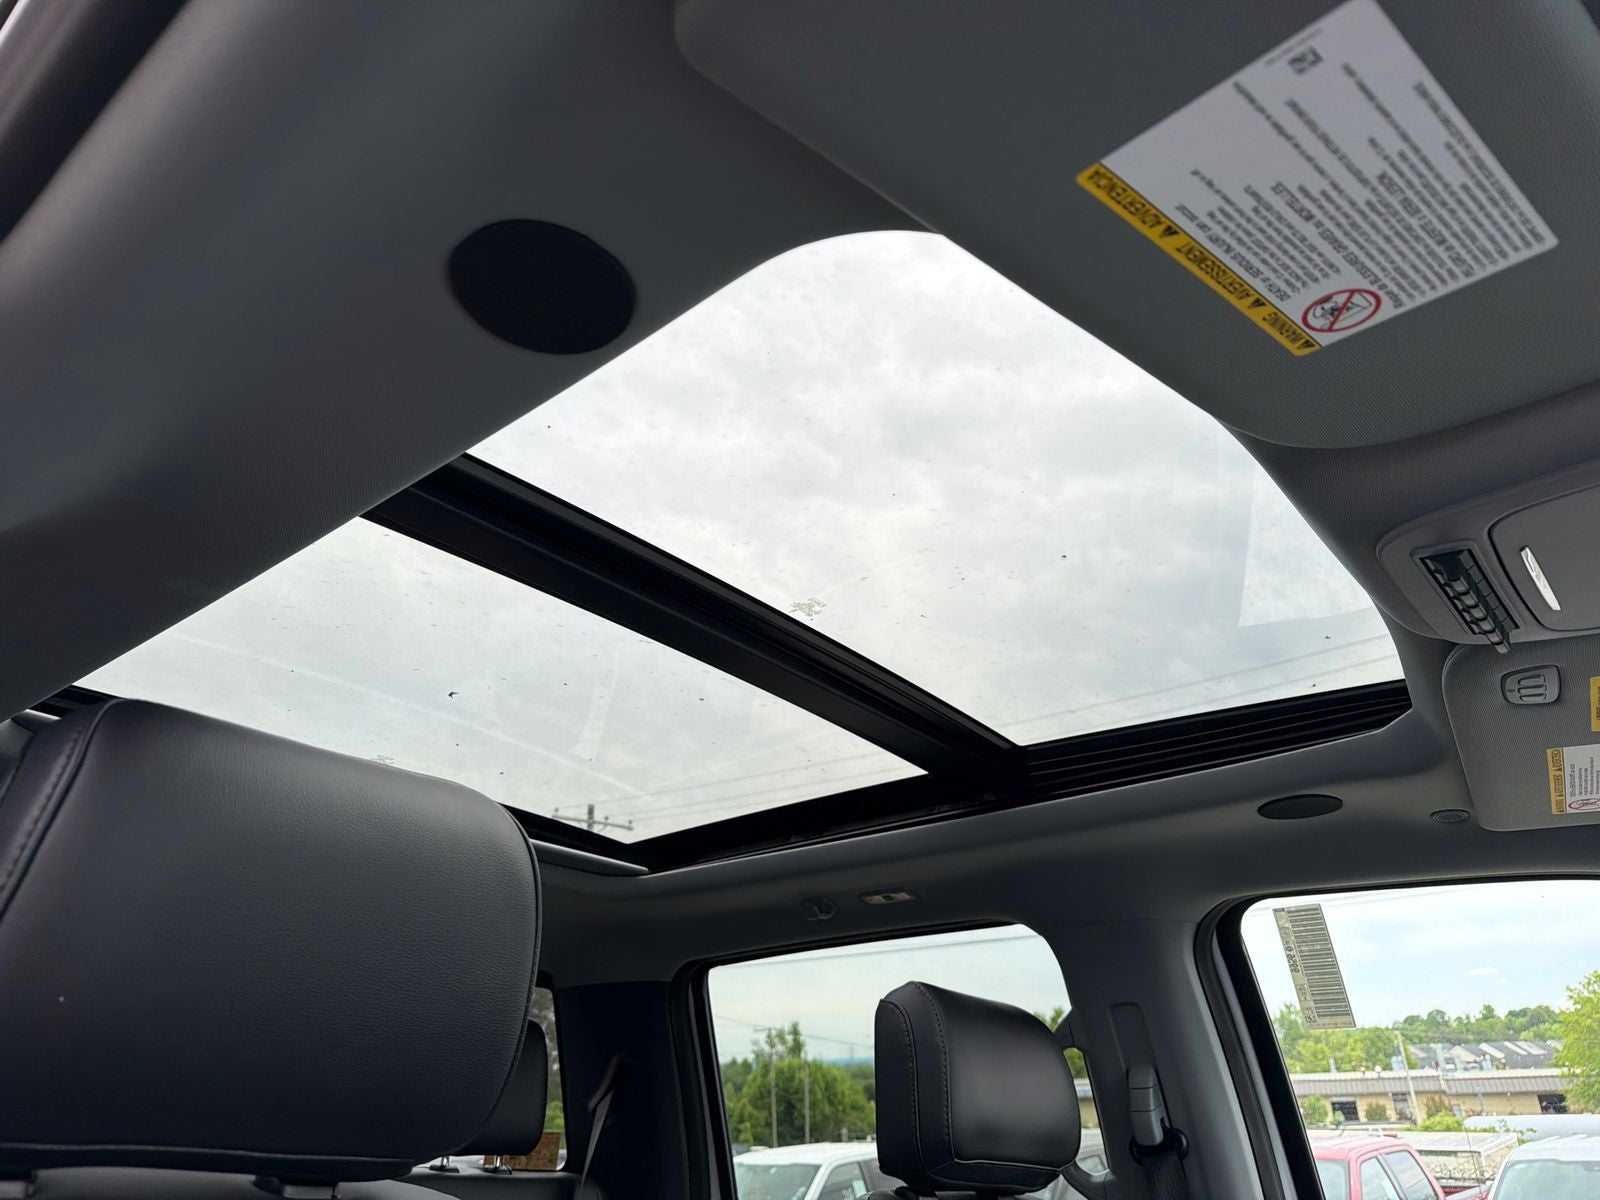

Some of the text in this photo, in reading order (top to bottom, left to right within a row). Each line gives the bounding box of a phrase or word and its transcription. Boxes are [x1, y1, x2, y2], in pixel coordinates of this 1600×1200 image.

[1084, 167, 1167, 231] ADVERTENCIA
[1205, 231, 1237, 255] INJURY
[1315, 227, 1349, 254] GRAVES
[1173, 240, 1255, 302] AVERTISSEMENT
[1228, 251, 1265, 279] SERIOUS
[1340, 250, 1382, 286] BLESSURES
[1263, 281, 1292, 302] DEATH
[1260, 310, 1308, 345] WARNING
